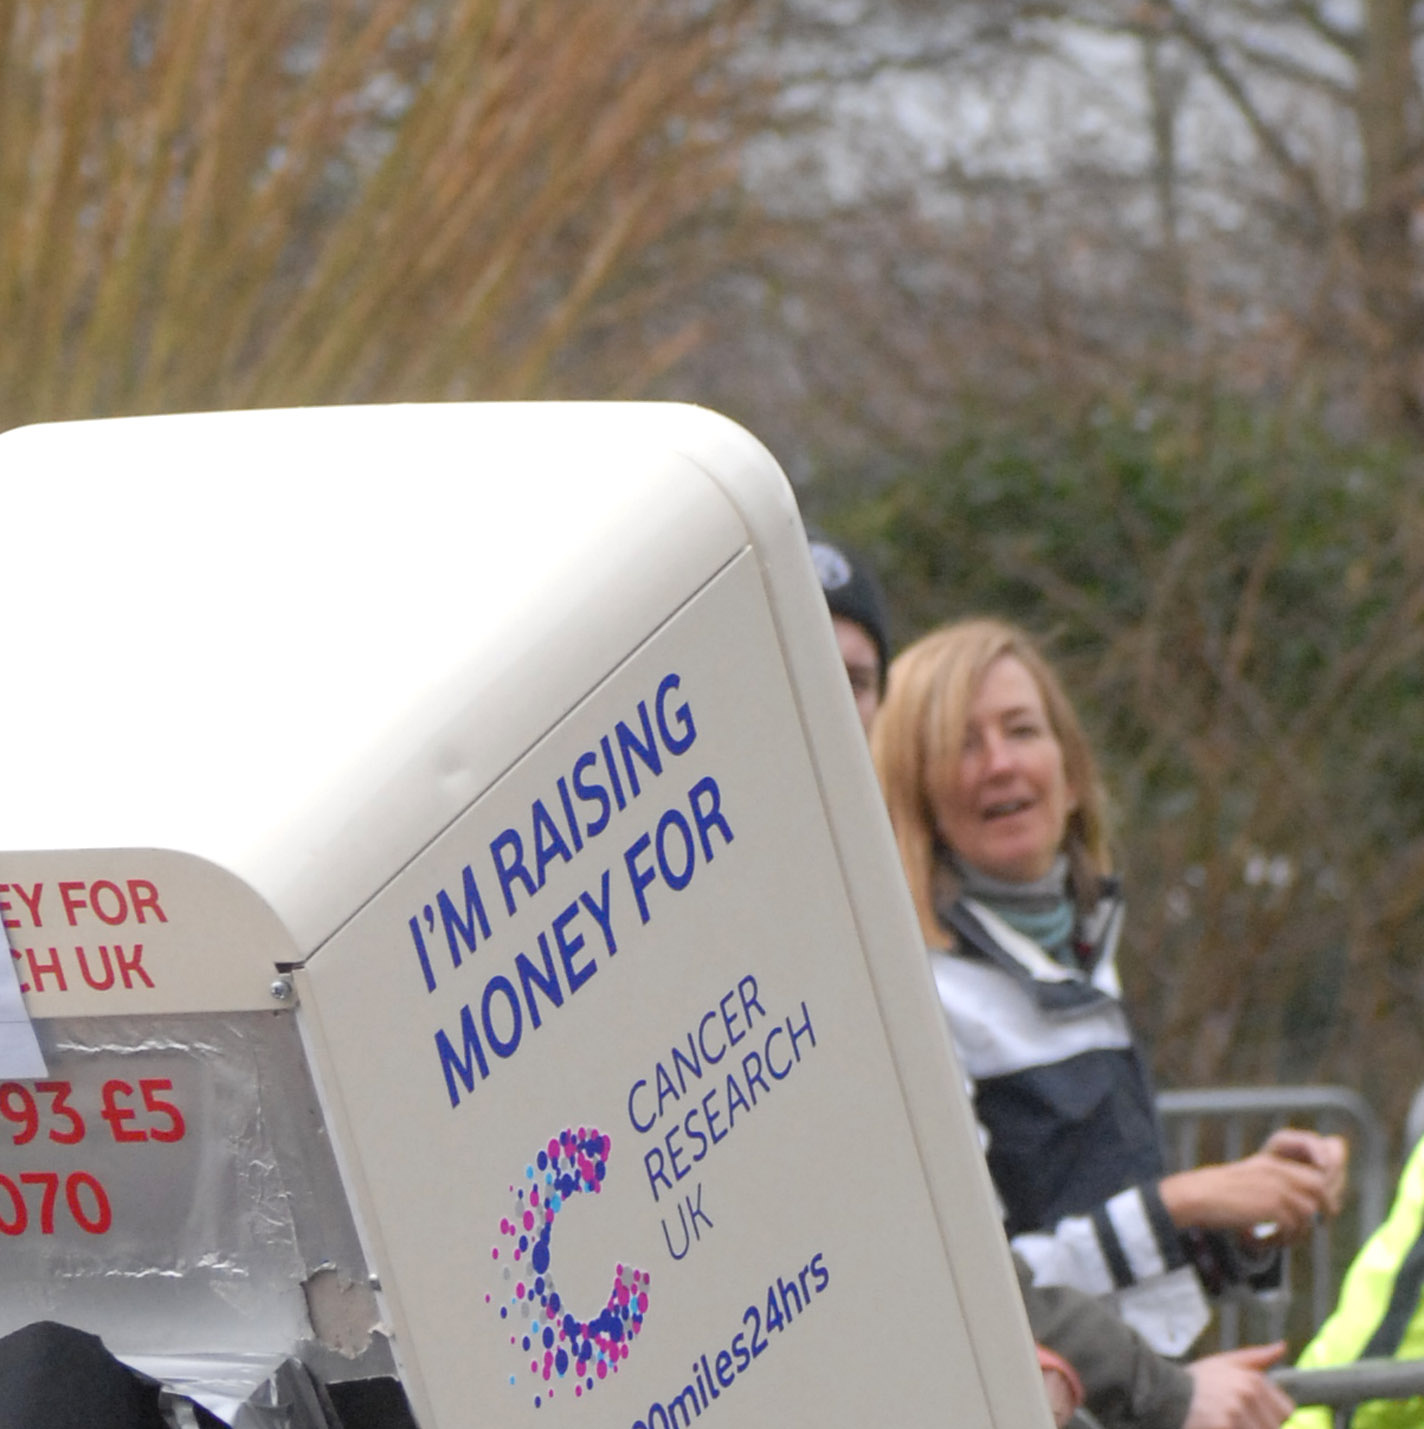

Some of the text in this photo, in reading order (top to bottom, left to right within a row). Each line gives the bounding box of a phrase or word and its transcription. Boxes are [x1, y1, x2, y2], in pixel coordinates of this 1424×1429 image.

[409, 672, 698, 992] I'M RAISING
[58, 878, 169, 927] FOR
[433, 774, 735, 1108] MONEY FOR
[74, 942, 156, 991] UK
[100, 1077, 188, 1144] £5
[628, 974, 767, 1134] CANCER
[645, 1002, 817, 1202] RESEARCH
[660, 1182, 716, 1263] UK
